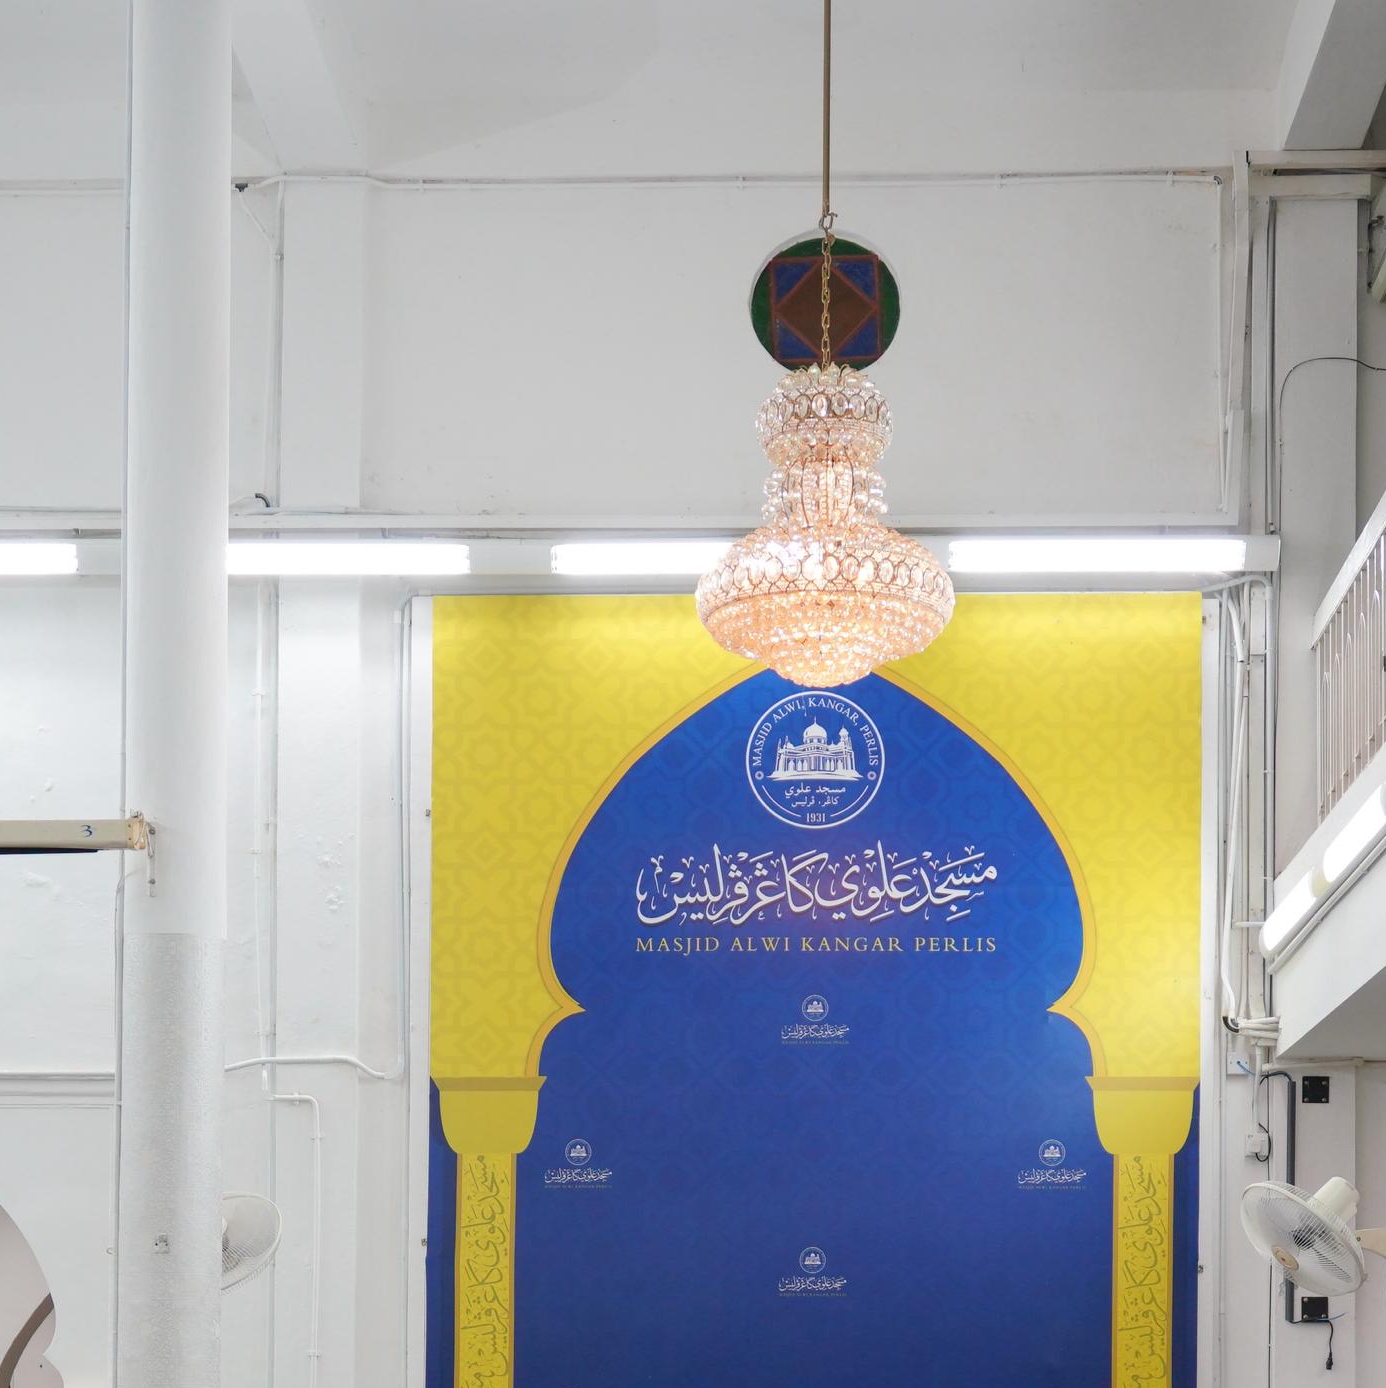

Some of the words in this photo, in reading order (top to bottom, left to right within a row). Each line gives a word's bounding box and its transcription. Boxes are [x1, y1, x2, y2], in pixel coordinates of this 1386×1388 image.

[752, 722, 772, 767] MASJID
[808, 697, 859, 727] KANGAR,
[859, 724, 879, 766] PERLIS
[815, 785, 846, 796] مسجد
[806, 813, 826, 823] 1931
[636, 937, 720, 956] MASJID
[730, 937, 790, 952] ALWI
[801, 937, 904, 952] KANGAR
[915, 937, 996, 952] PERLIS
